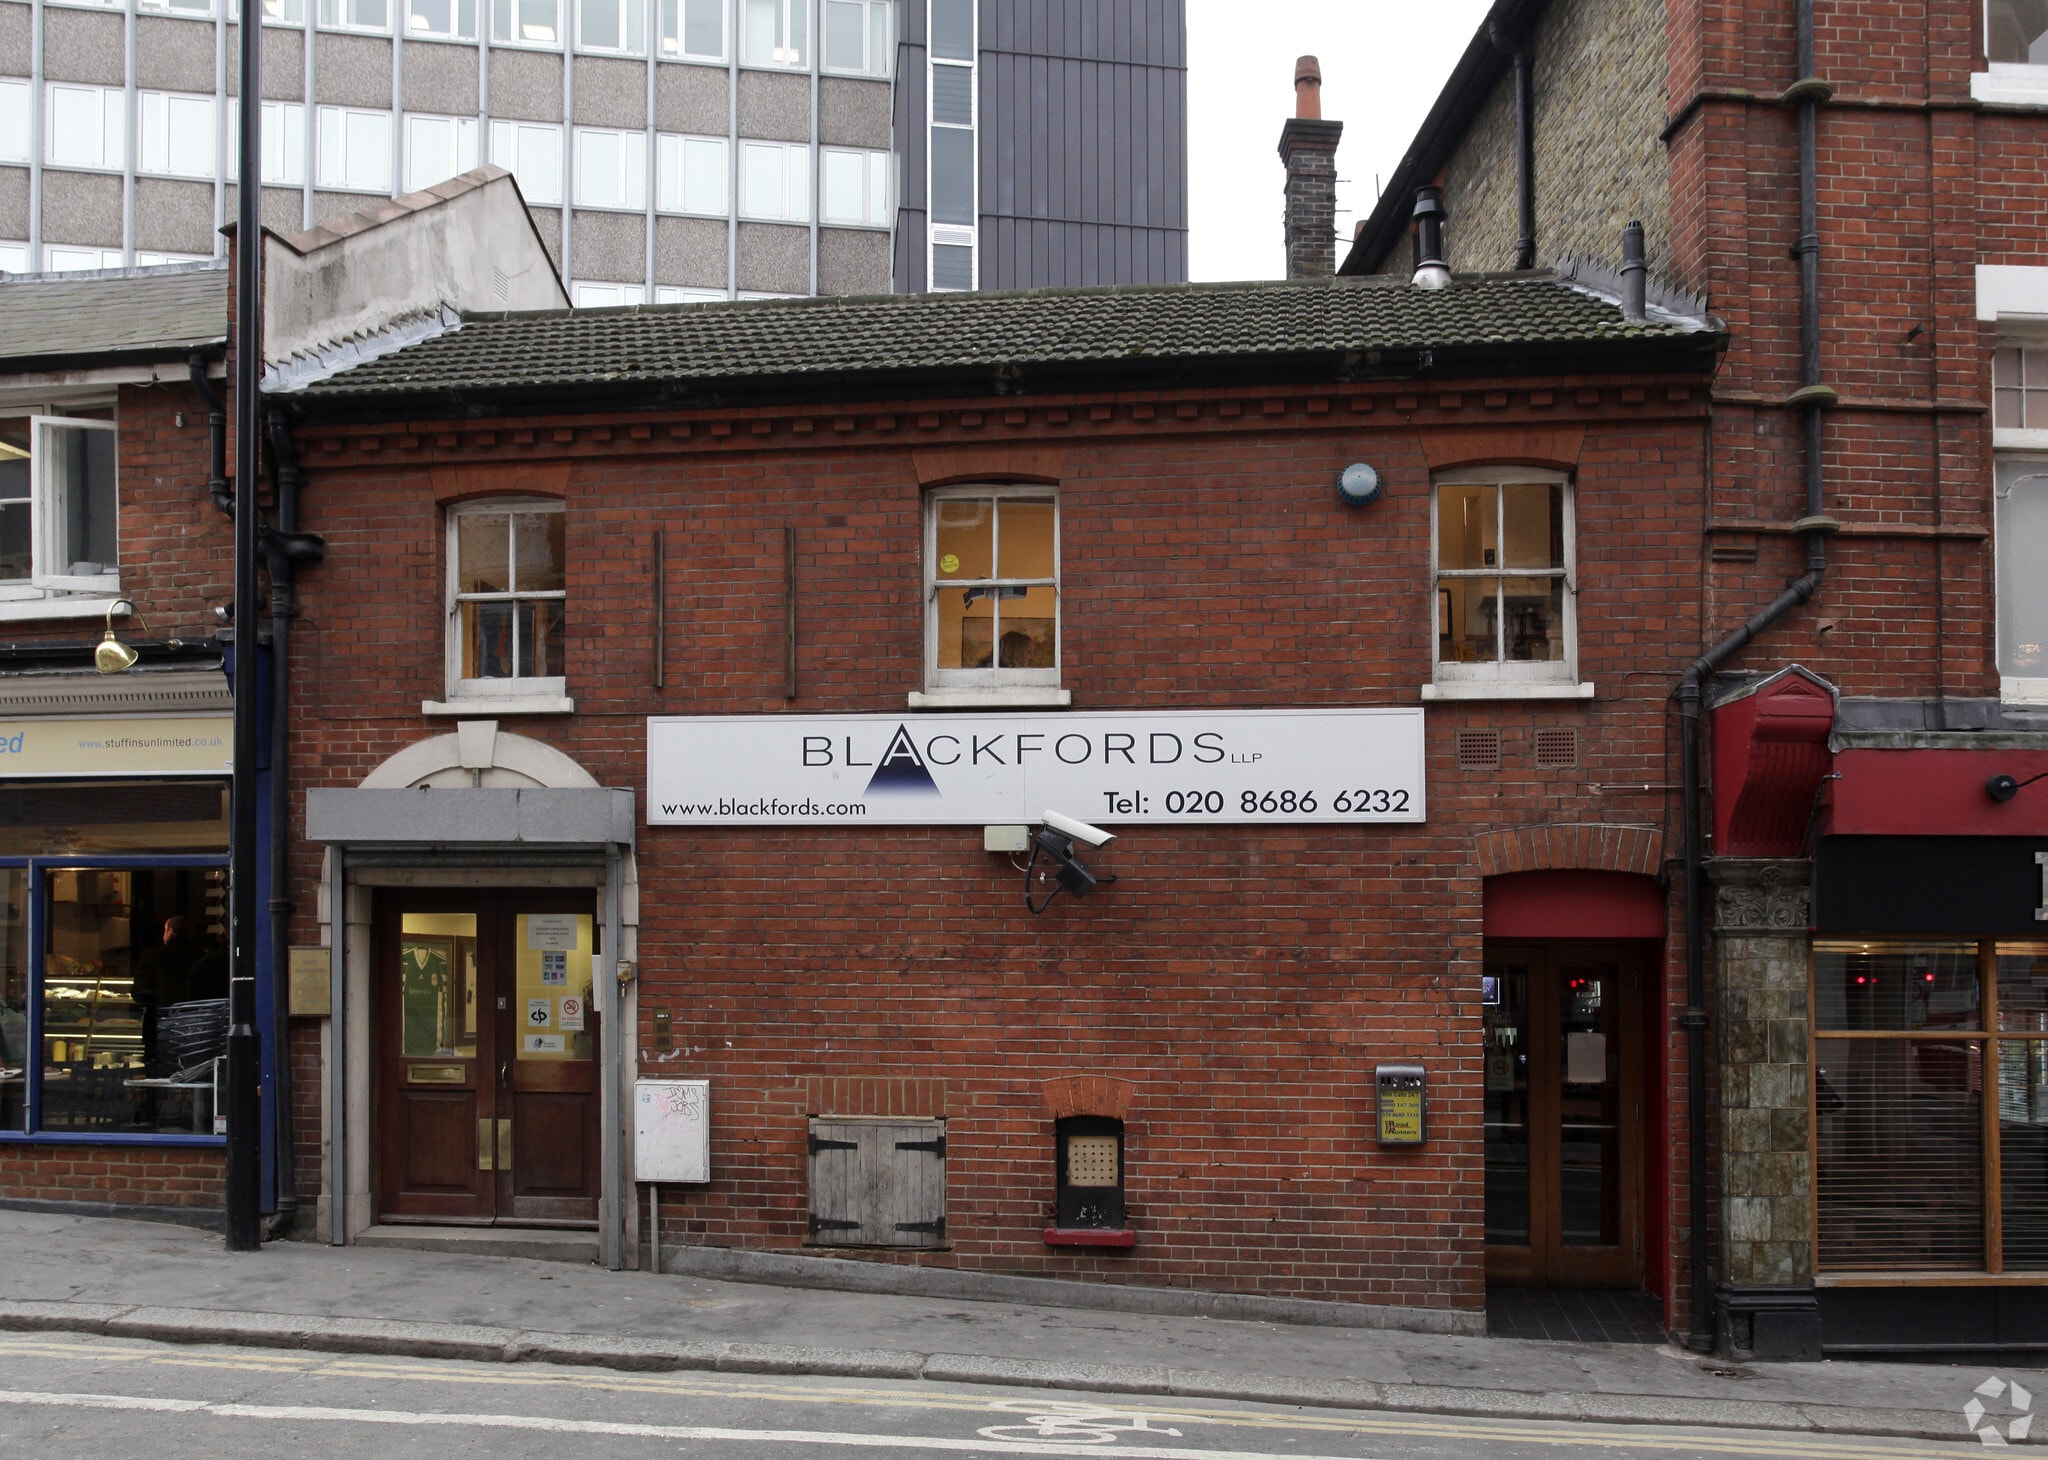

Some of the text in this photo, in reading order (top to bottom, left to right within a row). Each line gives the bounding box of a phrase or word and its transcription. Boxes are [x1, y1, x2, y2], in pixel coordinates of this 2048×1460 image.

[78, 736, 223, 749] www.stuffinsunlimited.co.uk
[802, 722, 1263, 767] BLACKFORDS LLP
[662, 798, 866, 816] www.blackfords.com
[1103, 789, 1410, 814] Tel: 020 8686 6232
[1389, 1120, 1409, 1128] Road
[1389, 1127, 1417, 1135] Runners
